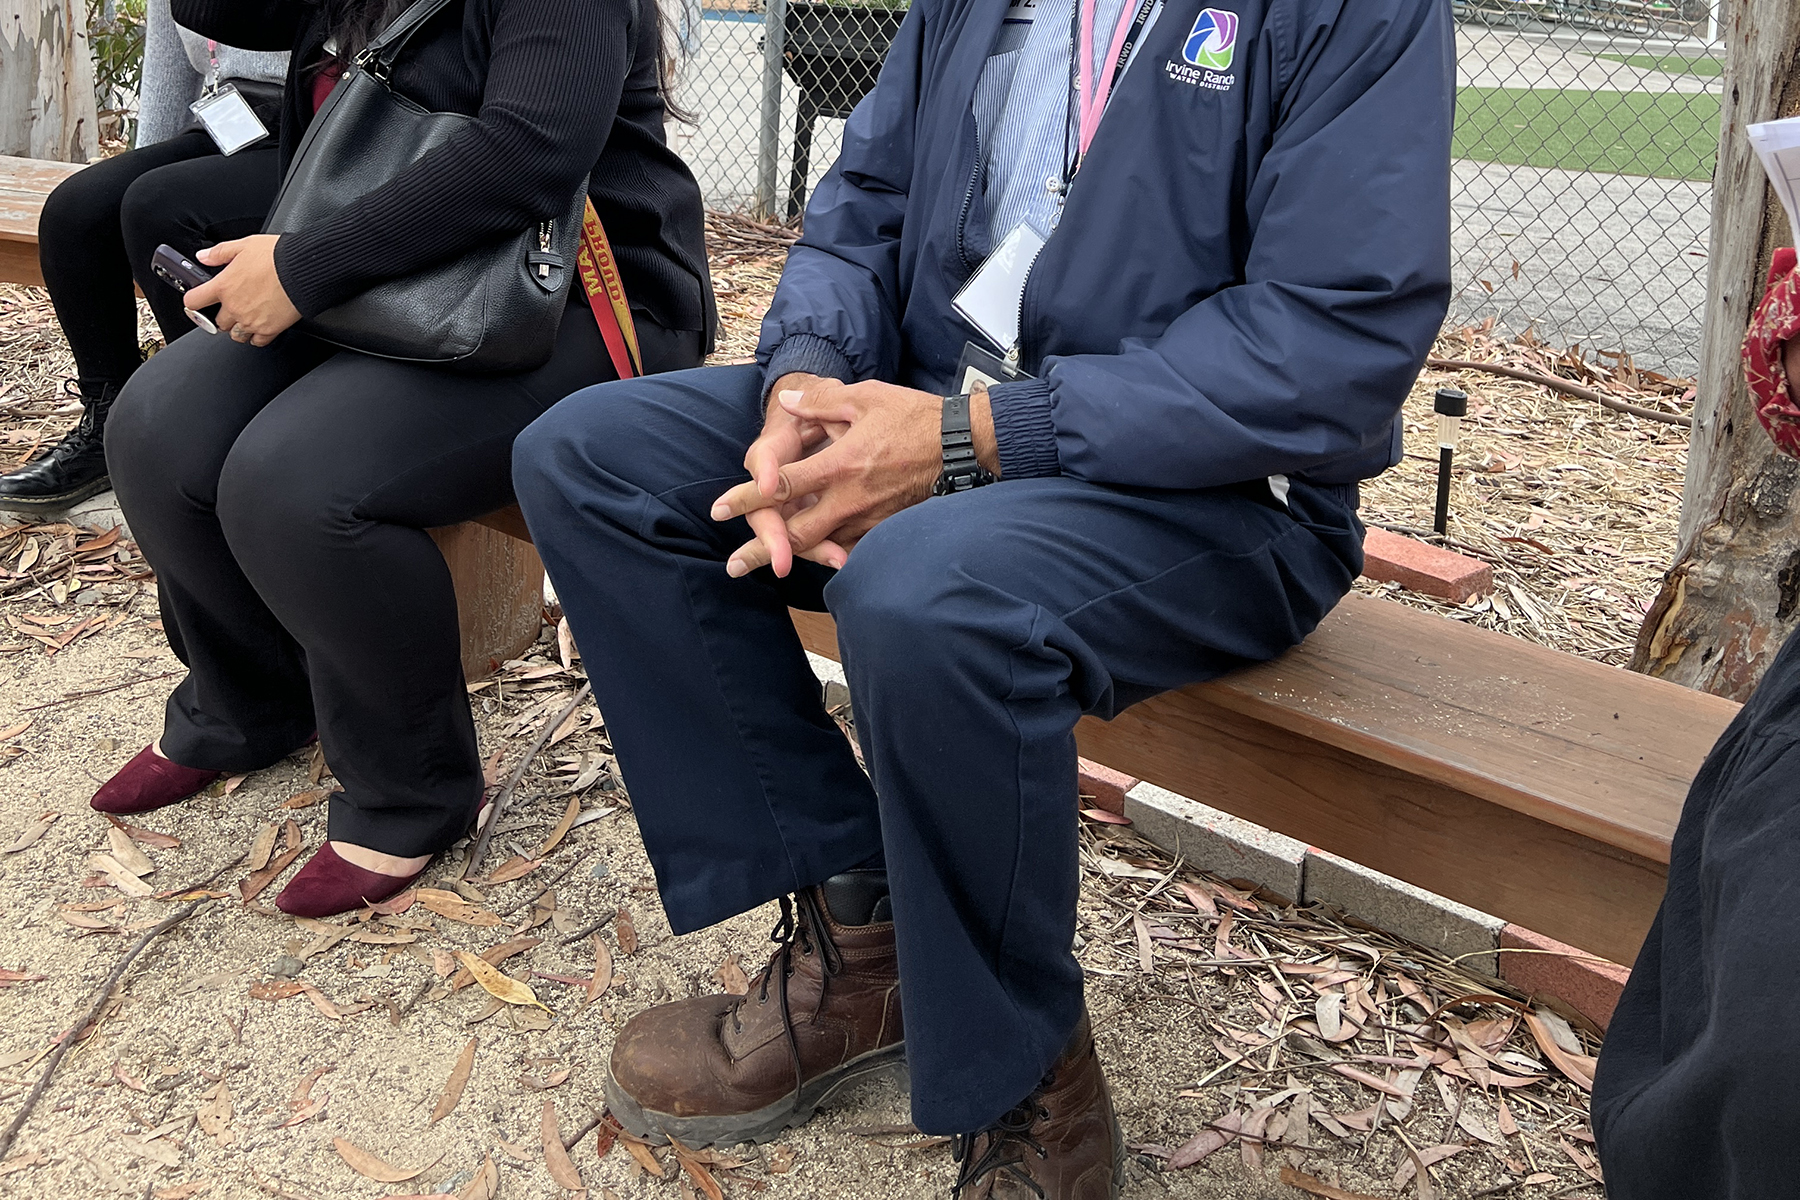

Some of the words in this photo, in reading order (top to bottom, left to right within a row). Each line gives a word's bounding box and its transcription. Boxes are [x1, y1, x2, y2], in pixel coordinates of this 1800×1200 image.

[1115, 41, 1133, 70] IRWD
[1165, 59, 1201, 80] Irvine
[1169, 72, 1197, 86] WATER
[1199, 80, 1231, 91] DISTRICT
[578, 238, 603, 298] MA
